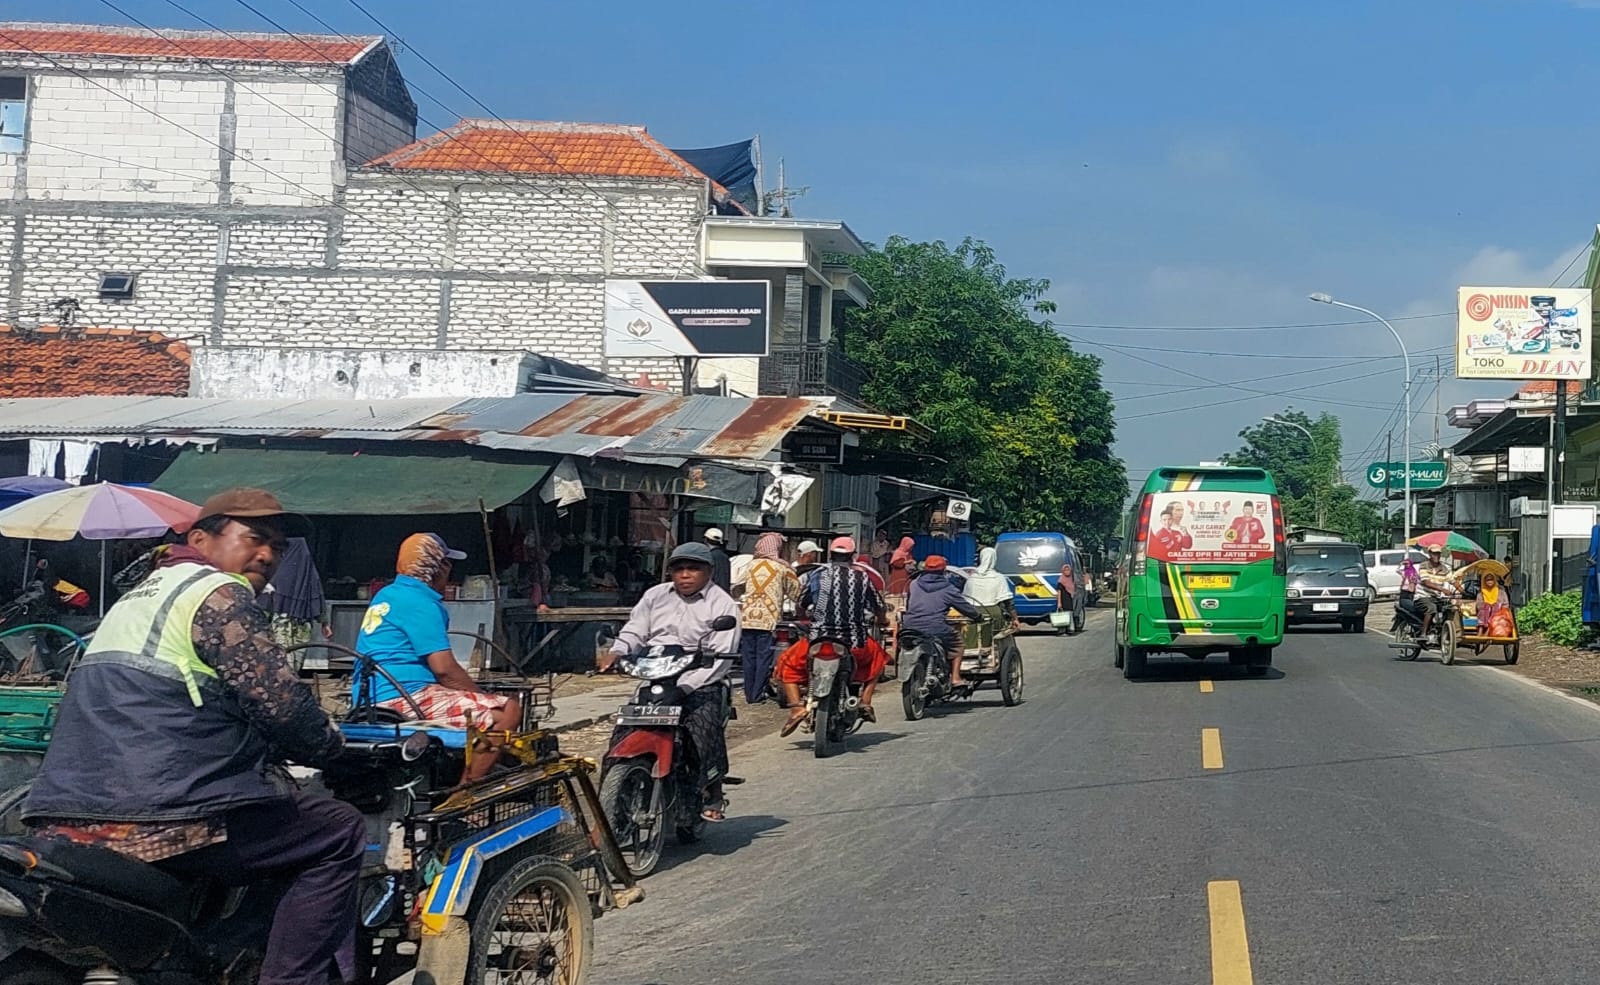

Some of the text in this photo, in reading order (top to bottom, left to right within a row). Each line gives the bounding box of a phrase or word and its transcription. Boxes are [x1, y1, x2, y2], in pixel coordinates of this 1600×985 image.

[1473, 358, 1586, 375] TOKO DIAN
[1396, 469, 1443, 479] BSMALAH
